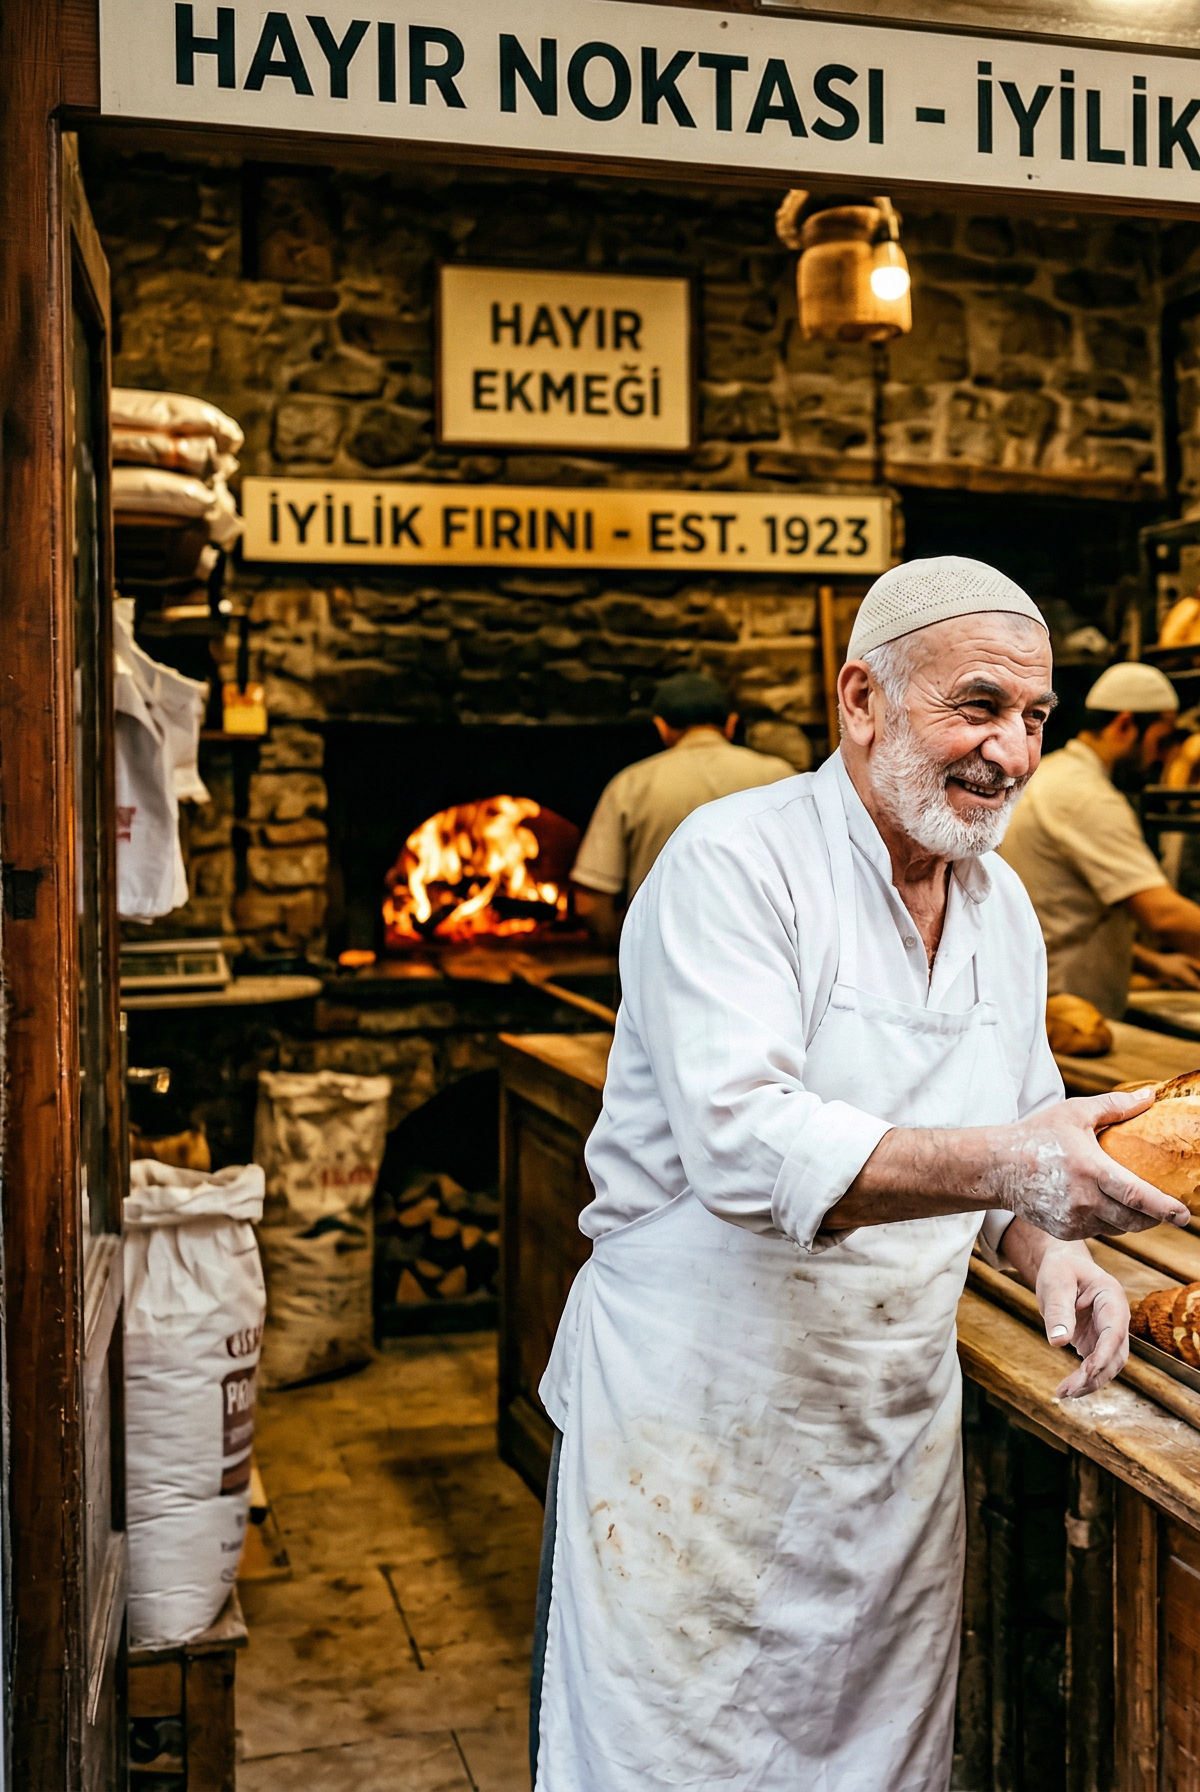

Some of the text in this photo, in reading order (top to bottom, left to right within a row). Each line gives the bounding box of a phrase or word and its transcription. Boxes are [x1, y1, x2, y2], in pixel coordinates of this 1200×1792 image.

[174, 2, 468, 110] HAYIR
[498, 33, 885, 146] NOKTASI
[915, 106, 946, 125] -
[489, 301, 644, 352] HAYIR
[471, 363, 662, 418] EKMEĞİ
[269, 491, 869, 557] İYİLİK FIRINI - EST. 1923
